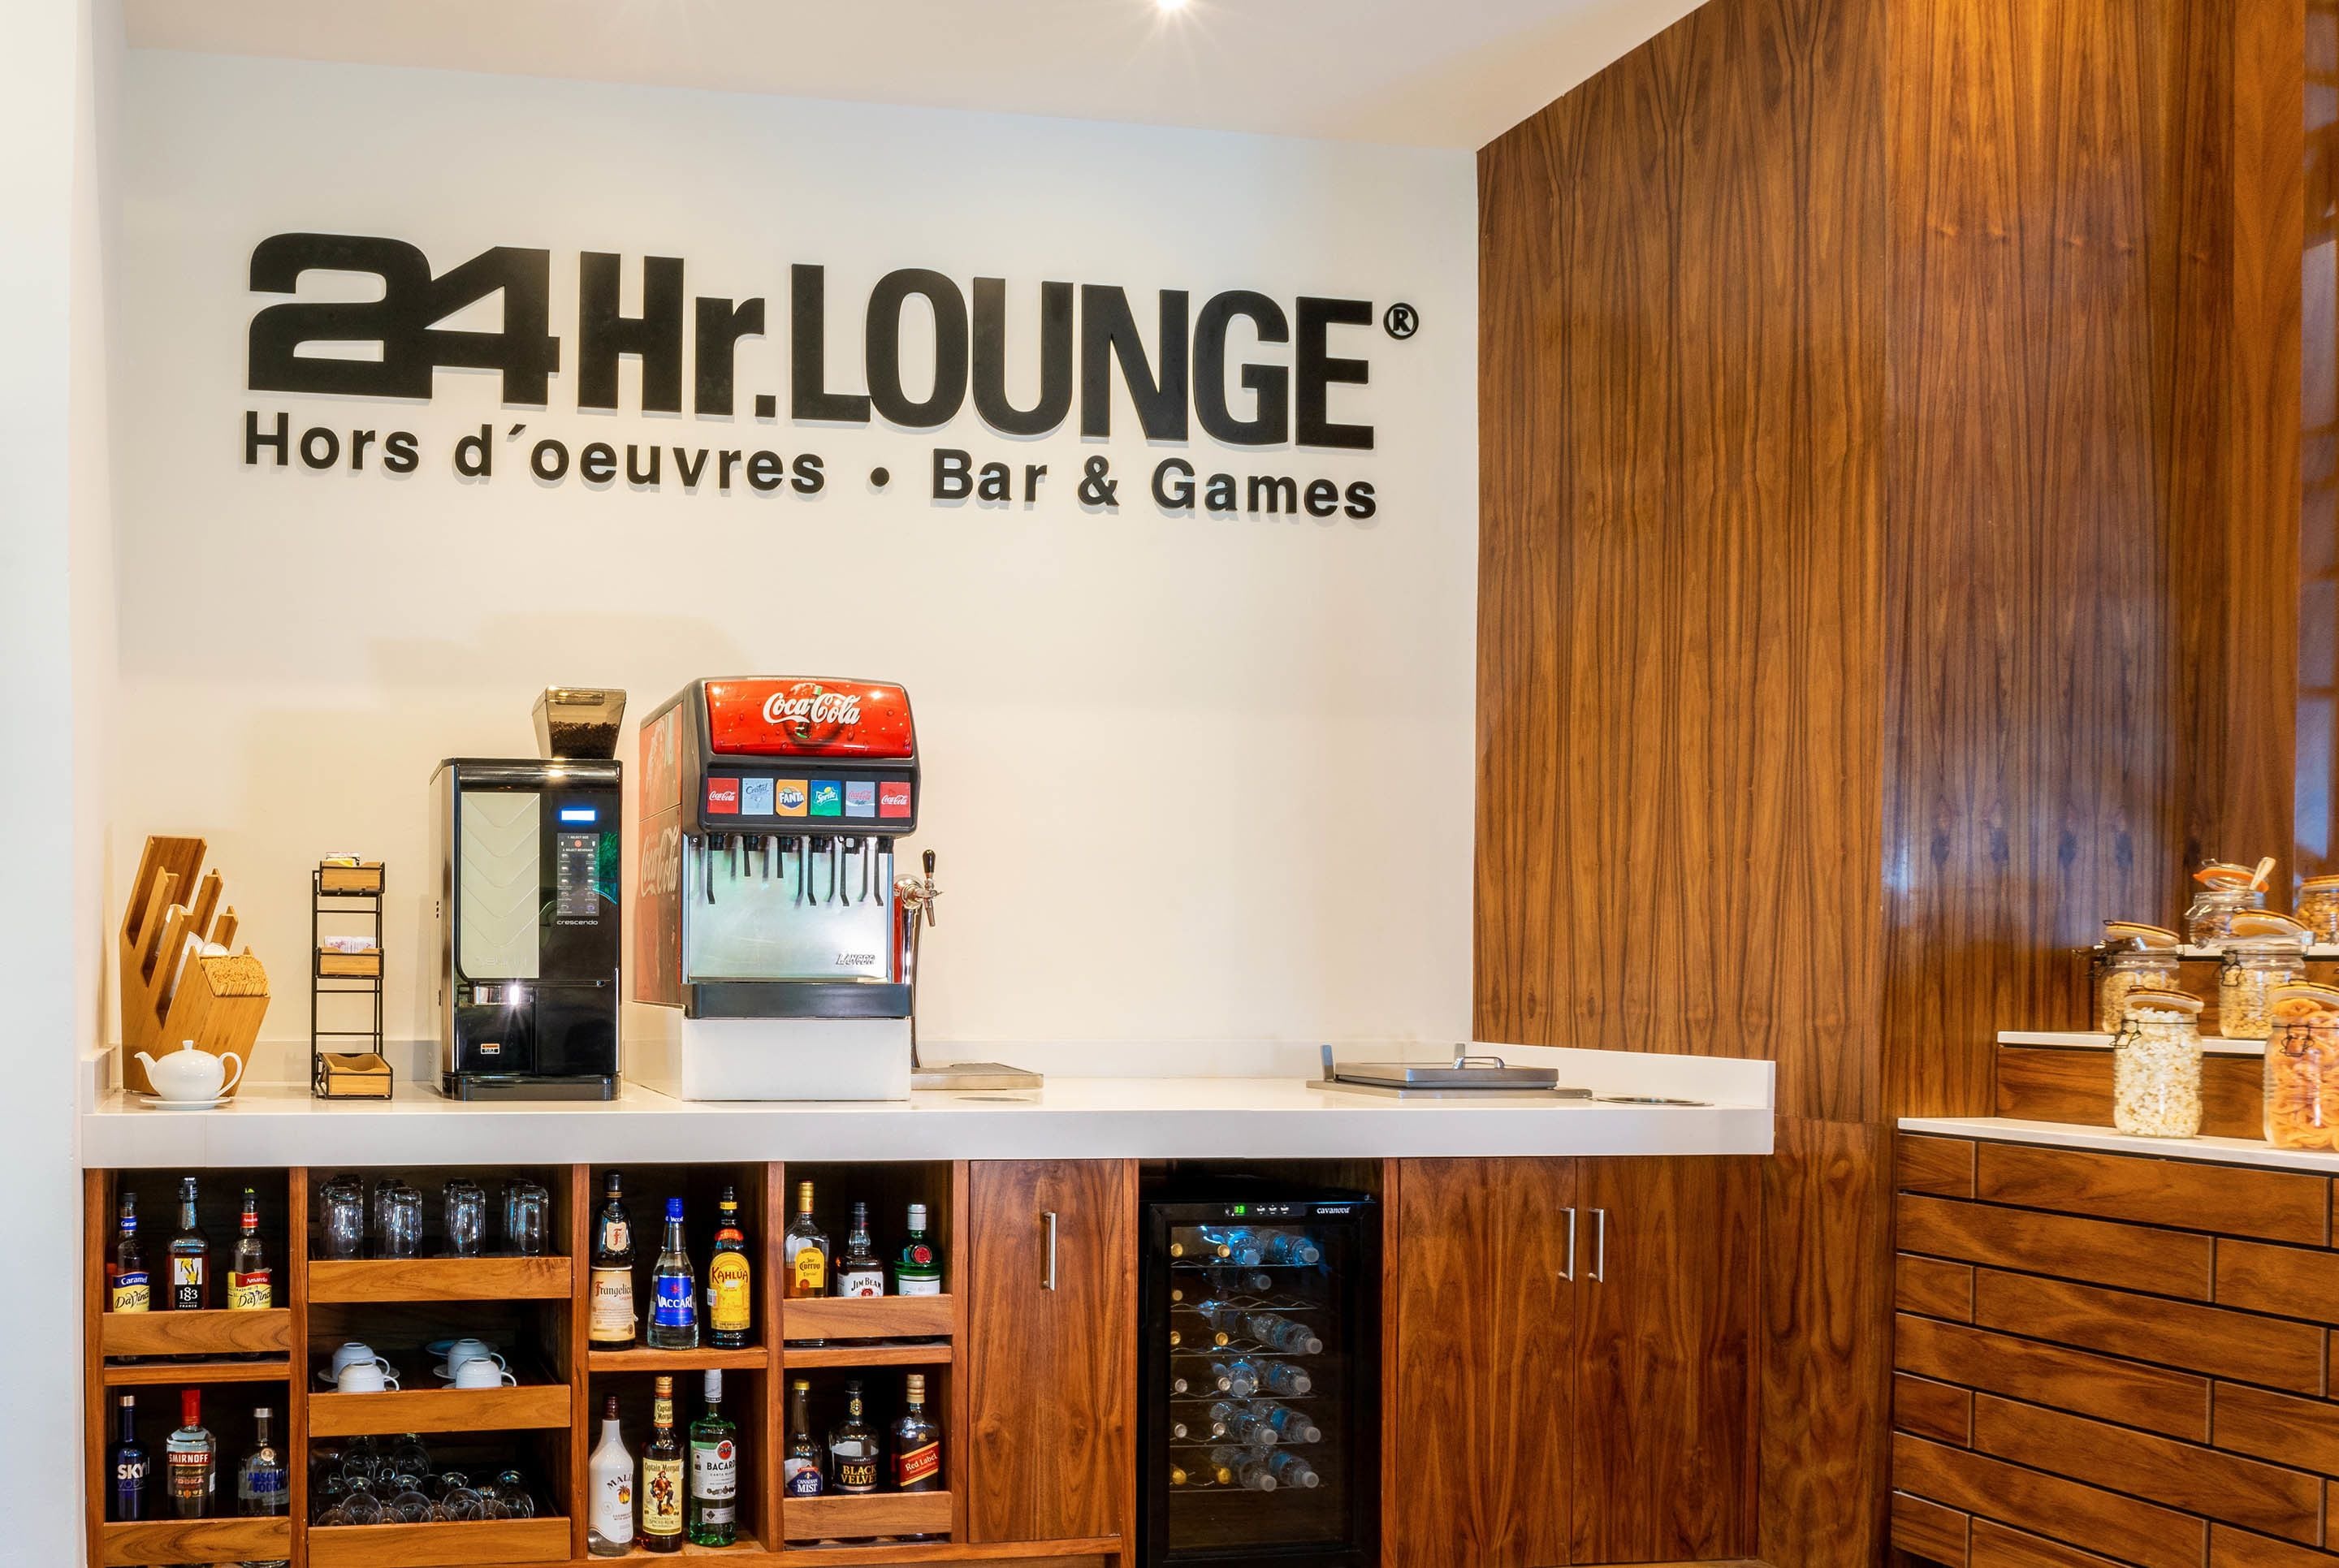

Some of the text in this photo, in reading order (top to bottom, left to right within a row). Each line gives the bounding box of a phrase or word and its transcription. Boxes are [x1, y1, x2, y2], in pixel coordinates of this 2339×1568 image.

[245, 410, 419, 473] Hors
[932, 448, 1048, 502] Bar
[1078, 456, 1120, 506] &
[1152, 458, 1377, 520] Games
[763, 692, 862, 724] Coca-Cola
[780, 791, 805, 803] FANTA
[817, 792, 837, 803] Sprite
[799, 1260, 820, 1272] Cuervo
[121, 1276, 148, 1285] Caramel
[711, 1266, 748, 1285] KAHLÚA
[851, 1280, 864, 1291] JIM
[657, 1294, 694, 1309] VACCARI
[168, 1454, 209, 1463] SMIRNOFF
[905, 1460, 920, 1471] Red
[919, 1452, 938, 1466] Label
[644, 1462, 680, 1474] Captain Morgan
[842, 1464, 876, 1475] BLACK
[797, 1484, 818, 1493] MIST
